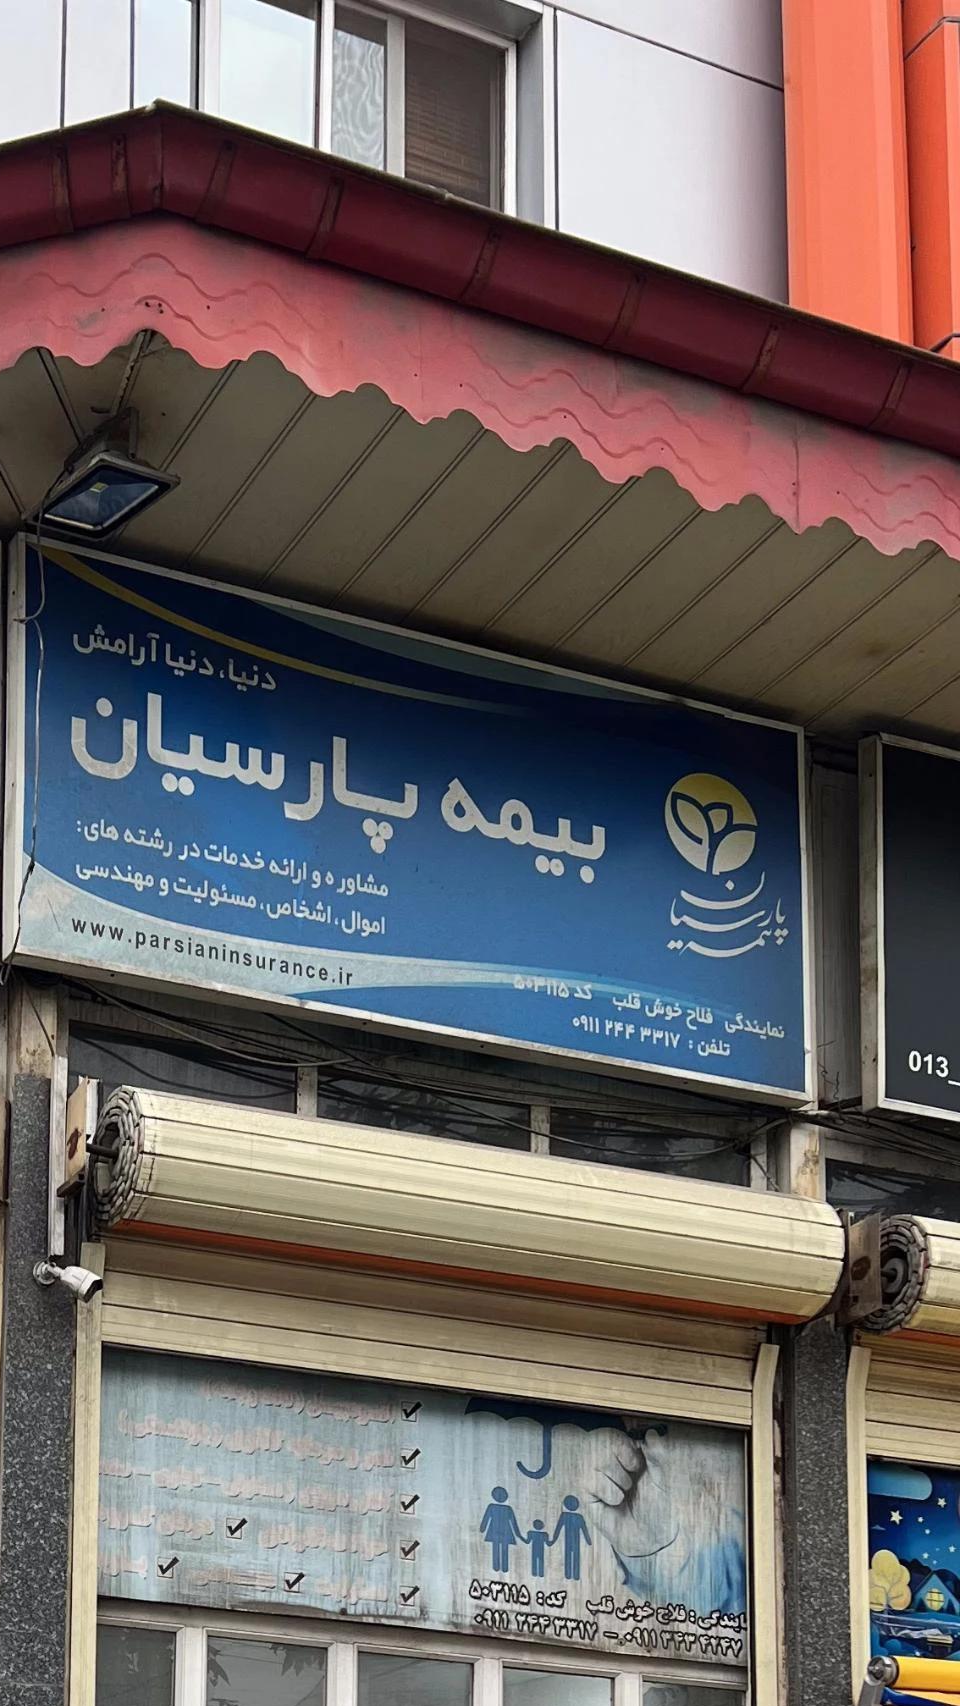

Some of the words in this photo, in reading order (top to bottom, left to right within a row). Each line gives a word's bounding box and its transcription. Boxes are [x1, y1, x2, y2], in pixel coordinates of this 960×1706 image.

[73, 624, 160, 665] آرامش
[164, 643, 214, 678] دنیا
[71, 692, 419, 854] پارسیان
[123, 827, 173, 857] رشته
[440, 777, 606, 884] بیمه
[178, 841, 201, 861] در
[204, 844, 265, 869] خدمات
[75, 862, 155, 892] مهندسی
[268, 860, 307, 885] ارائه
[312, 869, 322, 889] و
[159, 877, 169, 896] و
[173, 877, 257, 908] مسئولیت
[71, 917, 354, 986] www.parsianinsurance.ir
[513, 974, 570, 999] ۵۰۳۱۱۵
[574, 984, 592, 1000] کد
[613, 992, 640, 1011] قلب
[644, 1002, 682, 1021] خوش
[686, 1006, 713, 1030] فلاح
[725, 1012, 785, 1040] نمایندگی
[572, 1015, 599, 1033] ۰۹۱۱
[605, 1019, 635, 1040] ۲۴۴
[639, 1026, 680, 1048] ۳۳۱۷
[469, 1579, 531, 1606] ۵۰۳۱۱۵
[586, 1596, 615, 1616] قلب
[616, 1599, 655, 1622] خوش
[656, 1604, 687, 1624] فلاح
[474, 1609, 509, 1630] ۰۹۱۱
[553, 1617, 598, 1641] ۳۳۱۷
